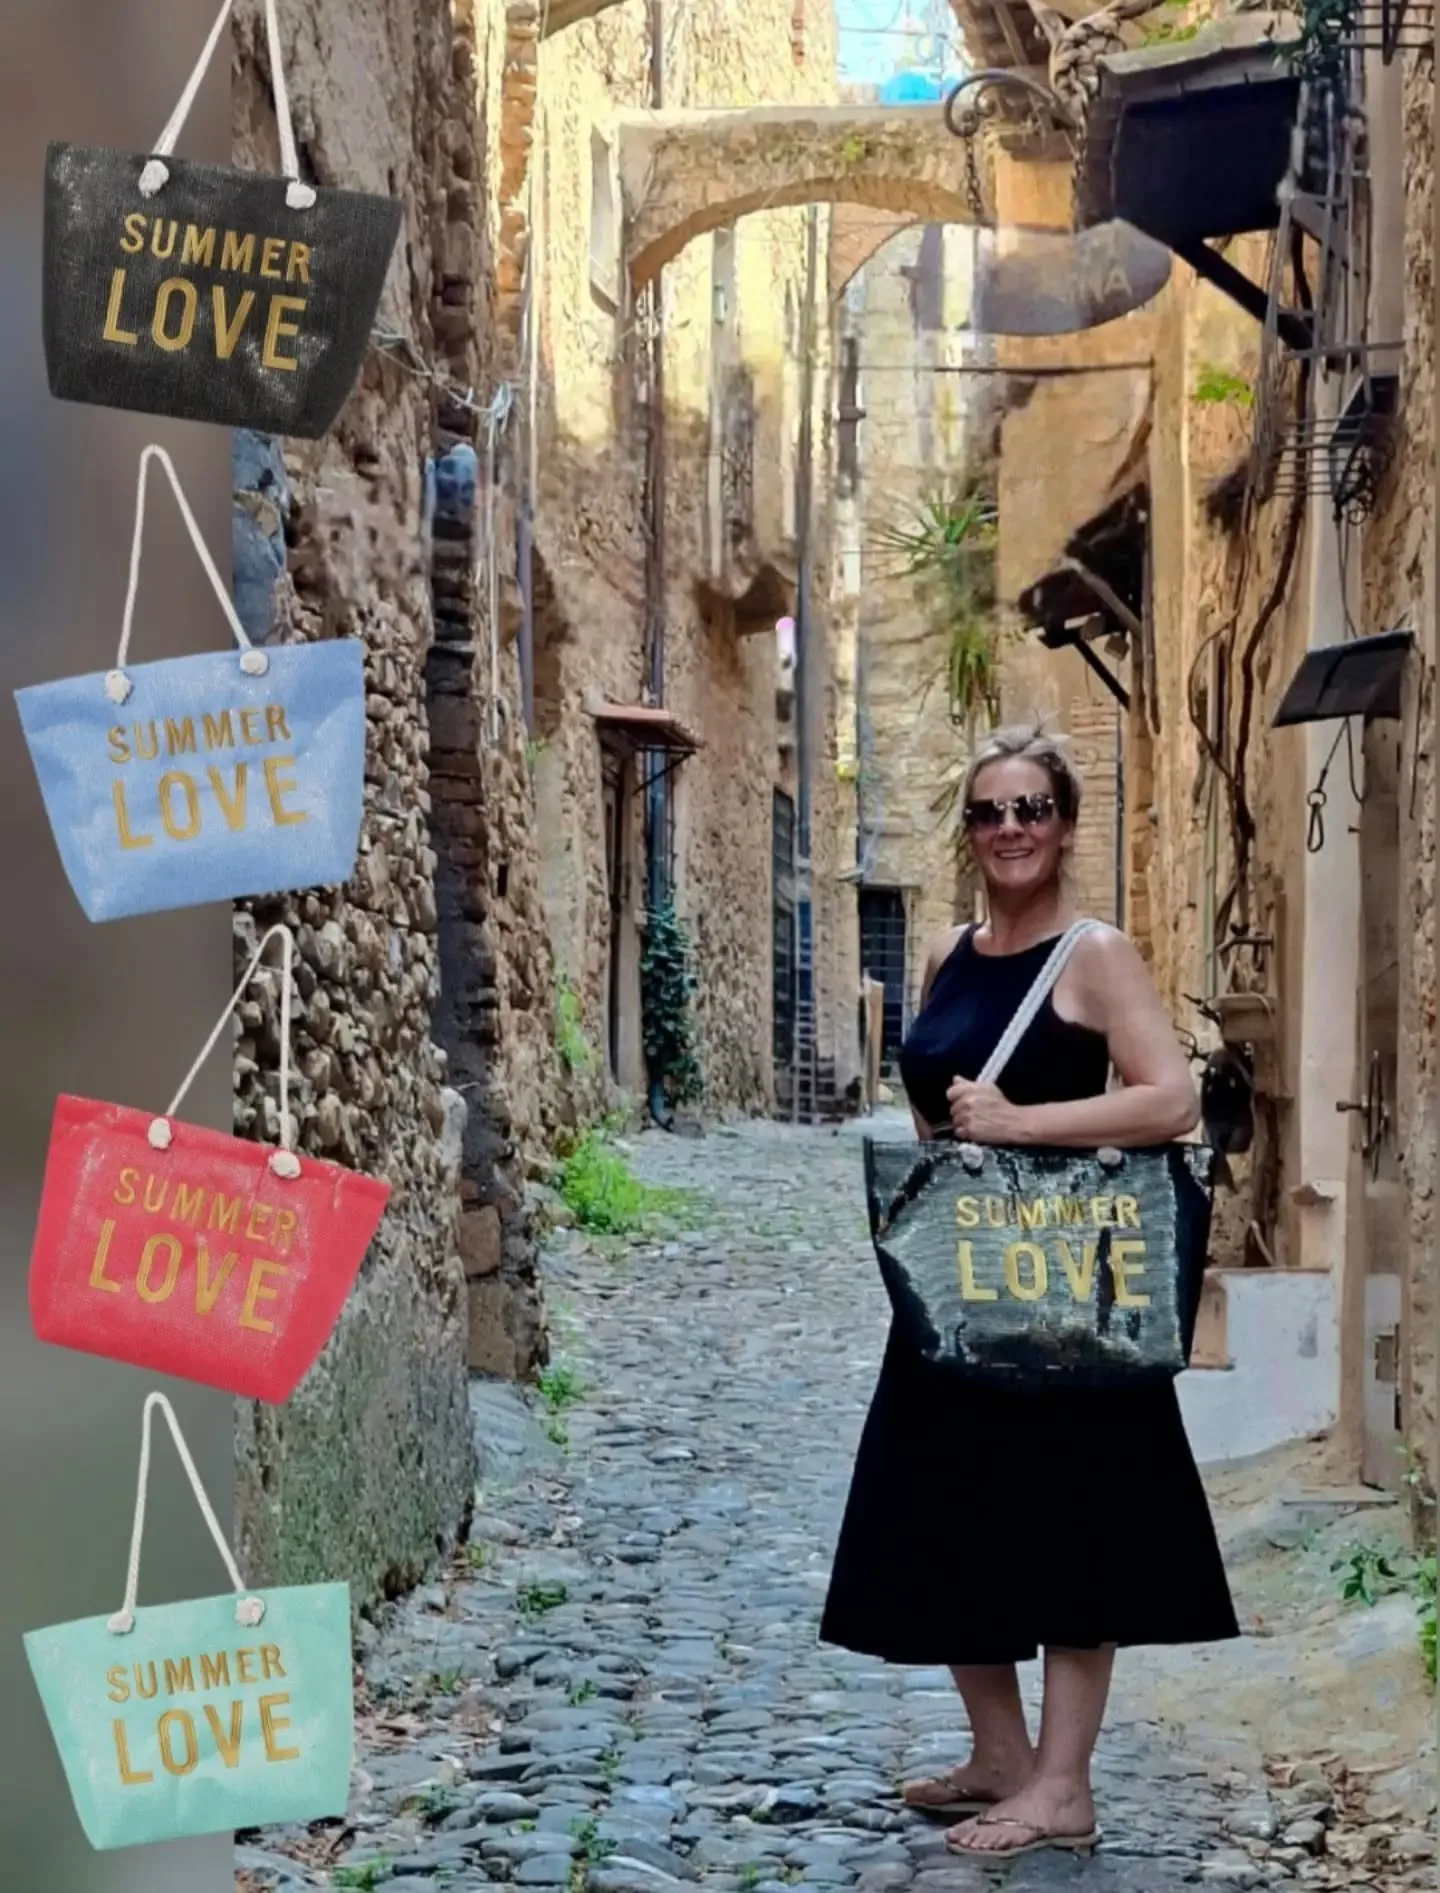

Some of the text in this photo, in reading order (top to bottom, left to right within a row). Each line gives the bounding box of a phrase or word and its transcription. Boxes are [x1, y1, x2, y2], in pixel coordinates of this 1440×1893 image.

[119, 213, 312, 284] SUMMER
[102, 267, 307, 371] LOVE
[107, 704, 291, 764] SUMMER
[112, 755, 309, 850] LOVE
[113, 1167, 297, 1250] SUMMER
[956, 1195, 1140, 1230] SUMMER
[89, 1219, 288, 1334] LOVE
[957, 1239, 1151, 1307] LOVE
[106, 1643, 287, 1703] SUMMER
[112, 1692, 300, 1785] LOVE
